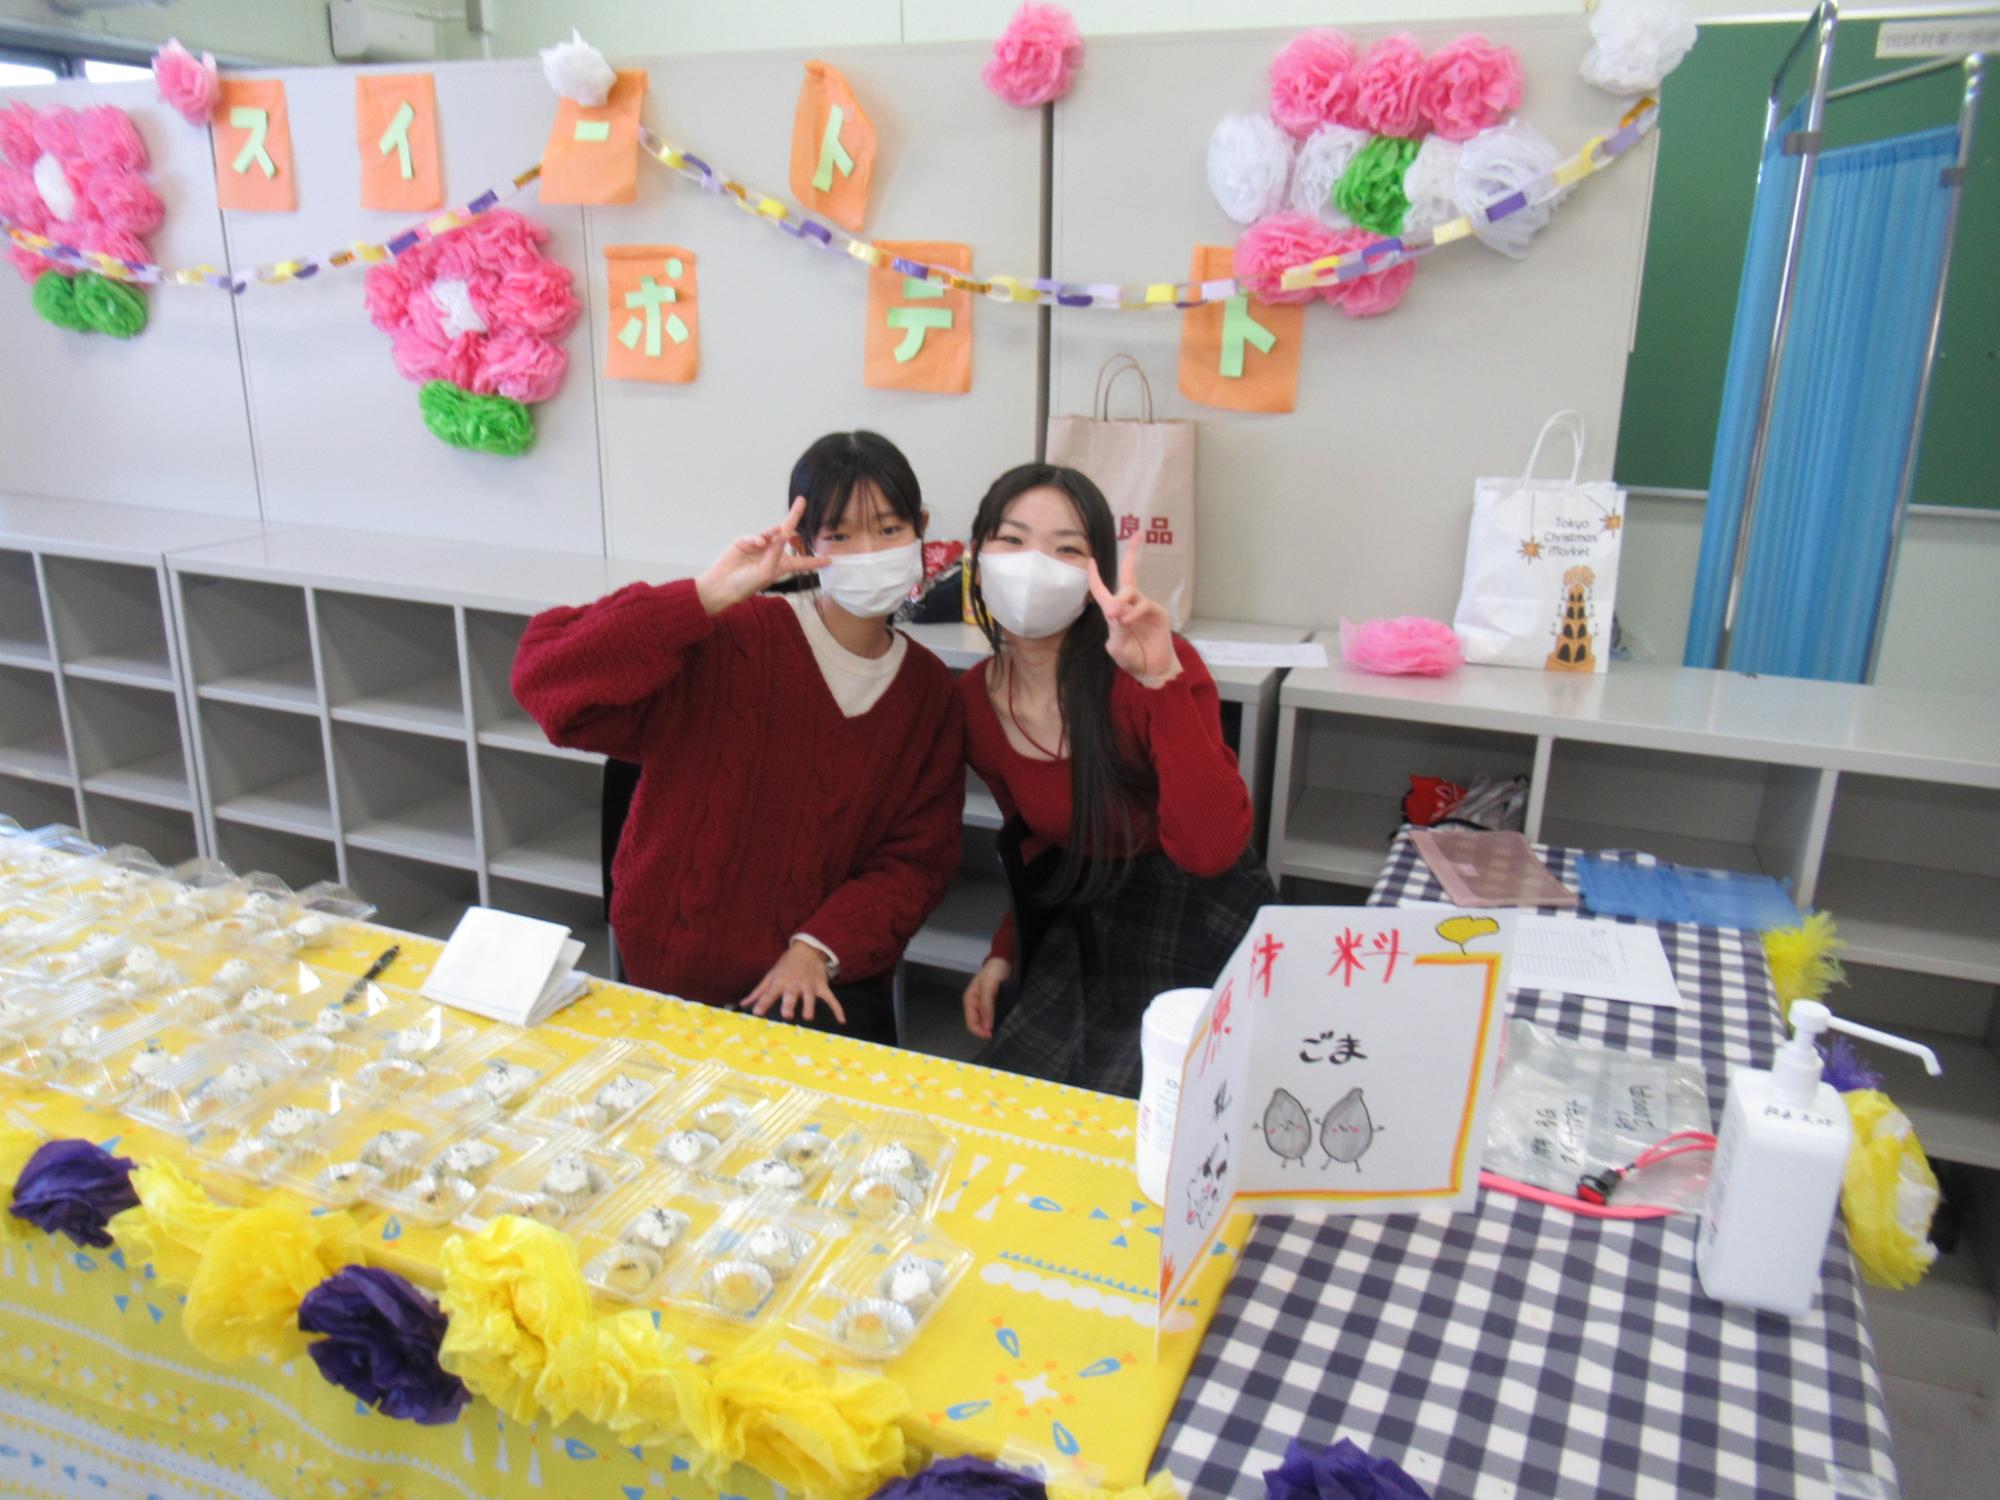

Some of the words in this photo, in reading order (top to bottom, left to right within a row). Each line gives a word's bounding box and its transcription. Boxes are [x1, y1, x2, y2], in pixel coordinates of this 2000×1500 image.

[1118, 513, 1173, 545] 良品
[1555, 516, 1590, 530] Tokyo
[1544, 531, 1598, 543] Christmas
[1548, 545, 1590, 557] Market
[1299, 1030, 1368, 1065] ごま
